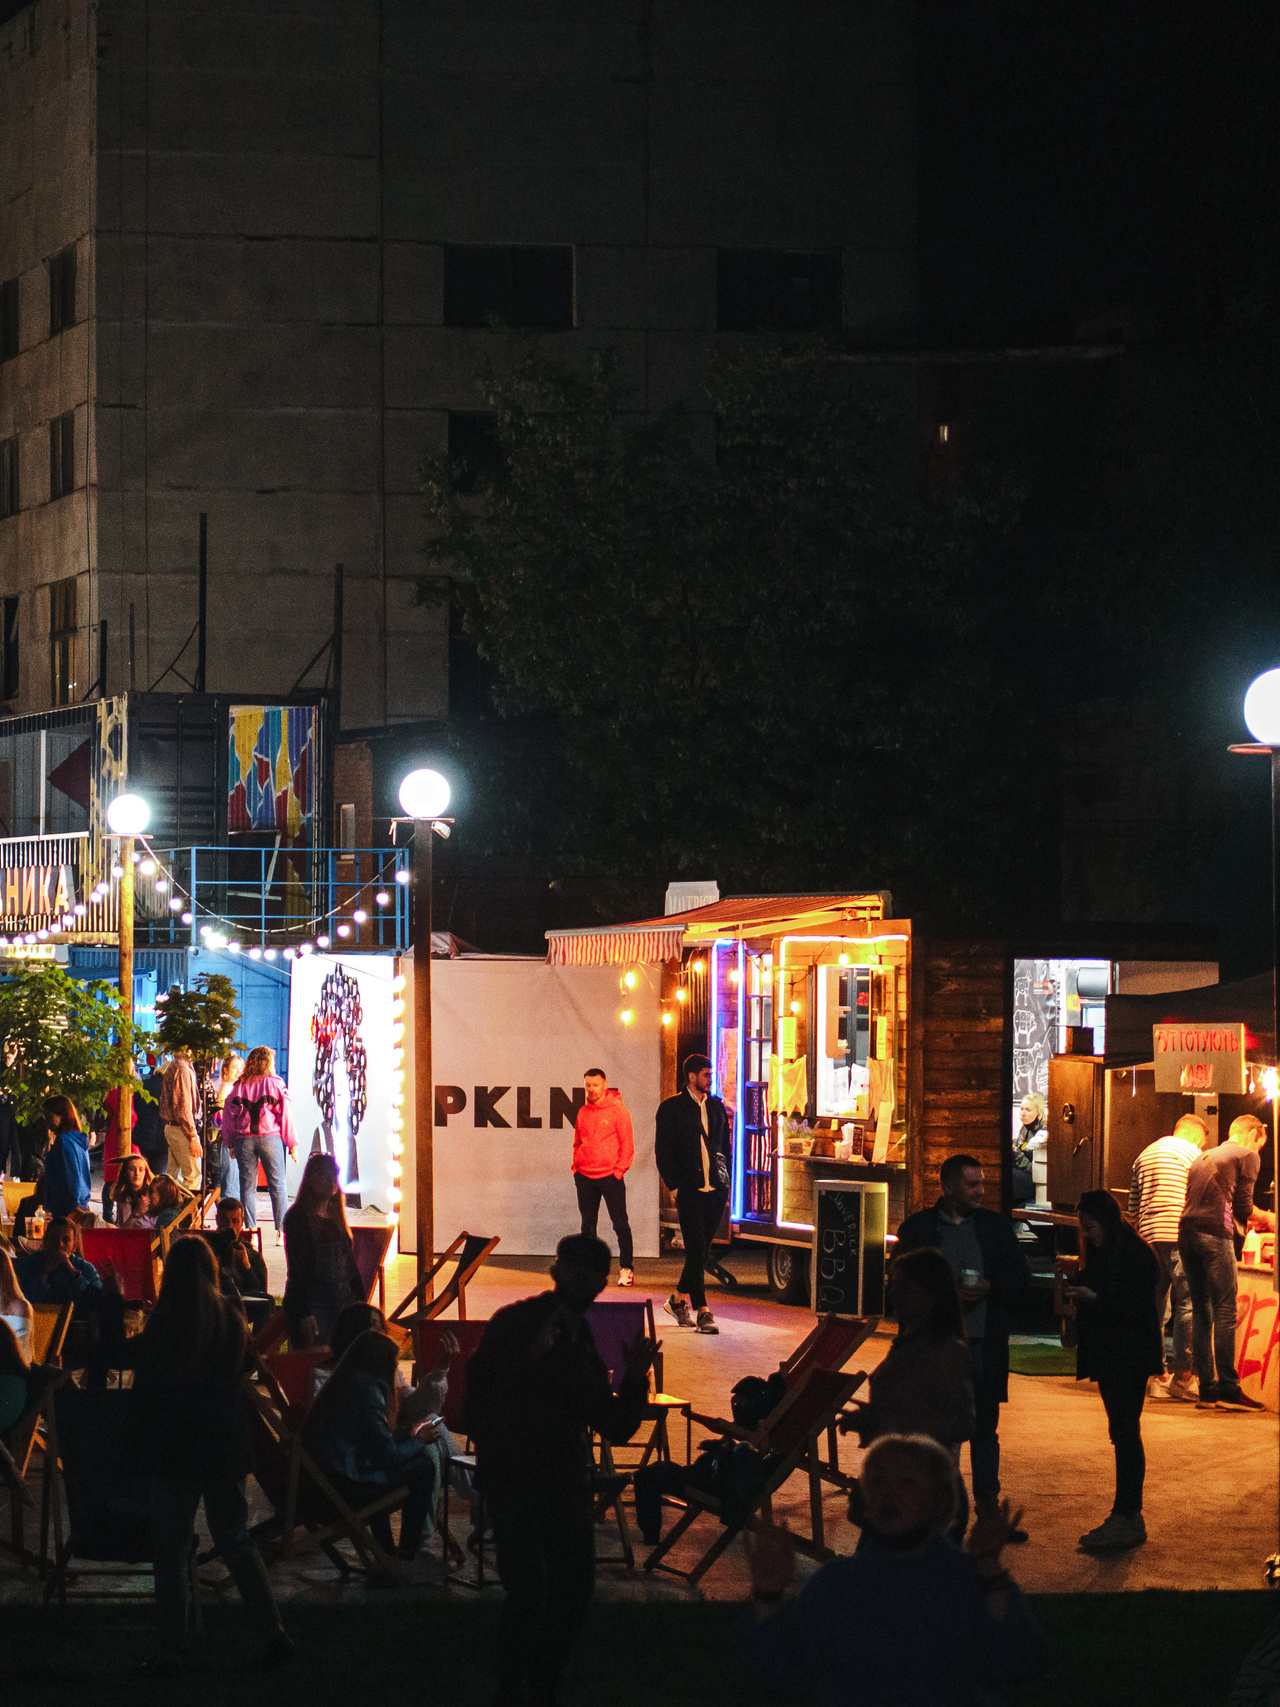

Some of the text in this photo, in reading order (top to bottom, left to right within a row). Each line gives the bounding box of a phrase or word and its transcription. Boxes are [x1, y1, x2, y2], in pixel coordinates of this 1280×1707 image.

[1180, 1029, 1240, 1052] ГОТУЮТЬ
[434, 1085, 618, 1129] PKLN
[818, 1228, 846, 1309] BBQ
